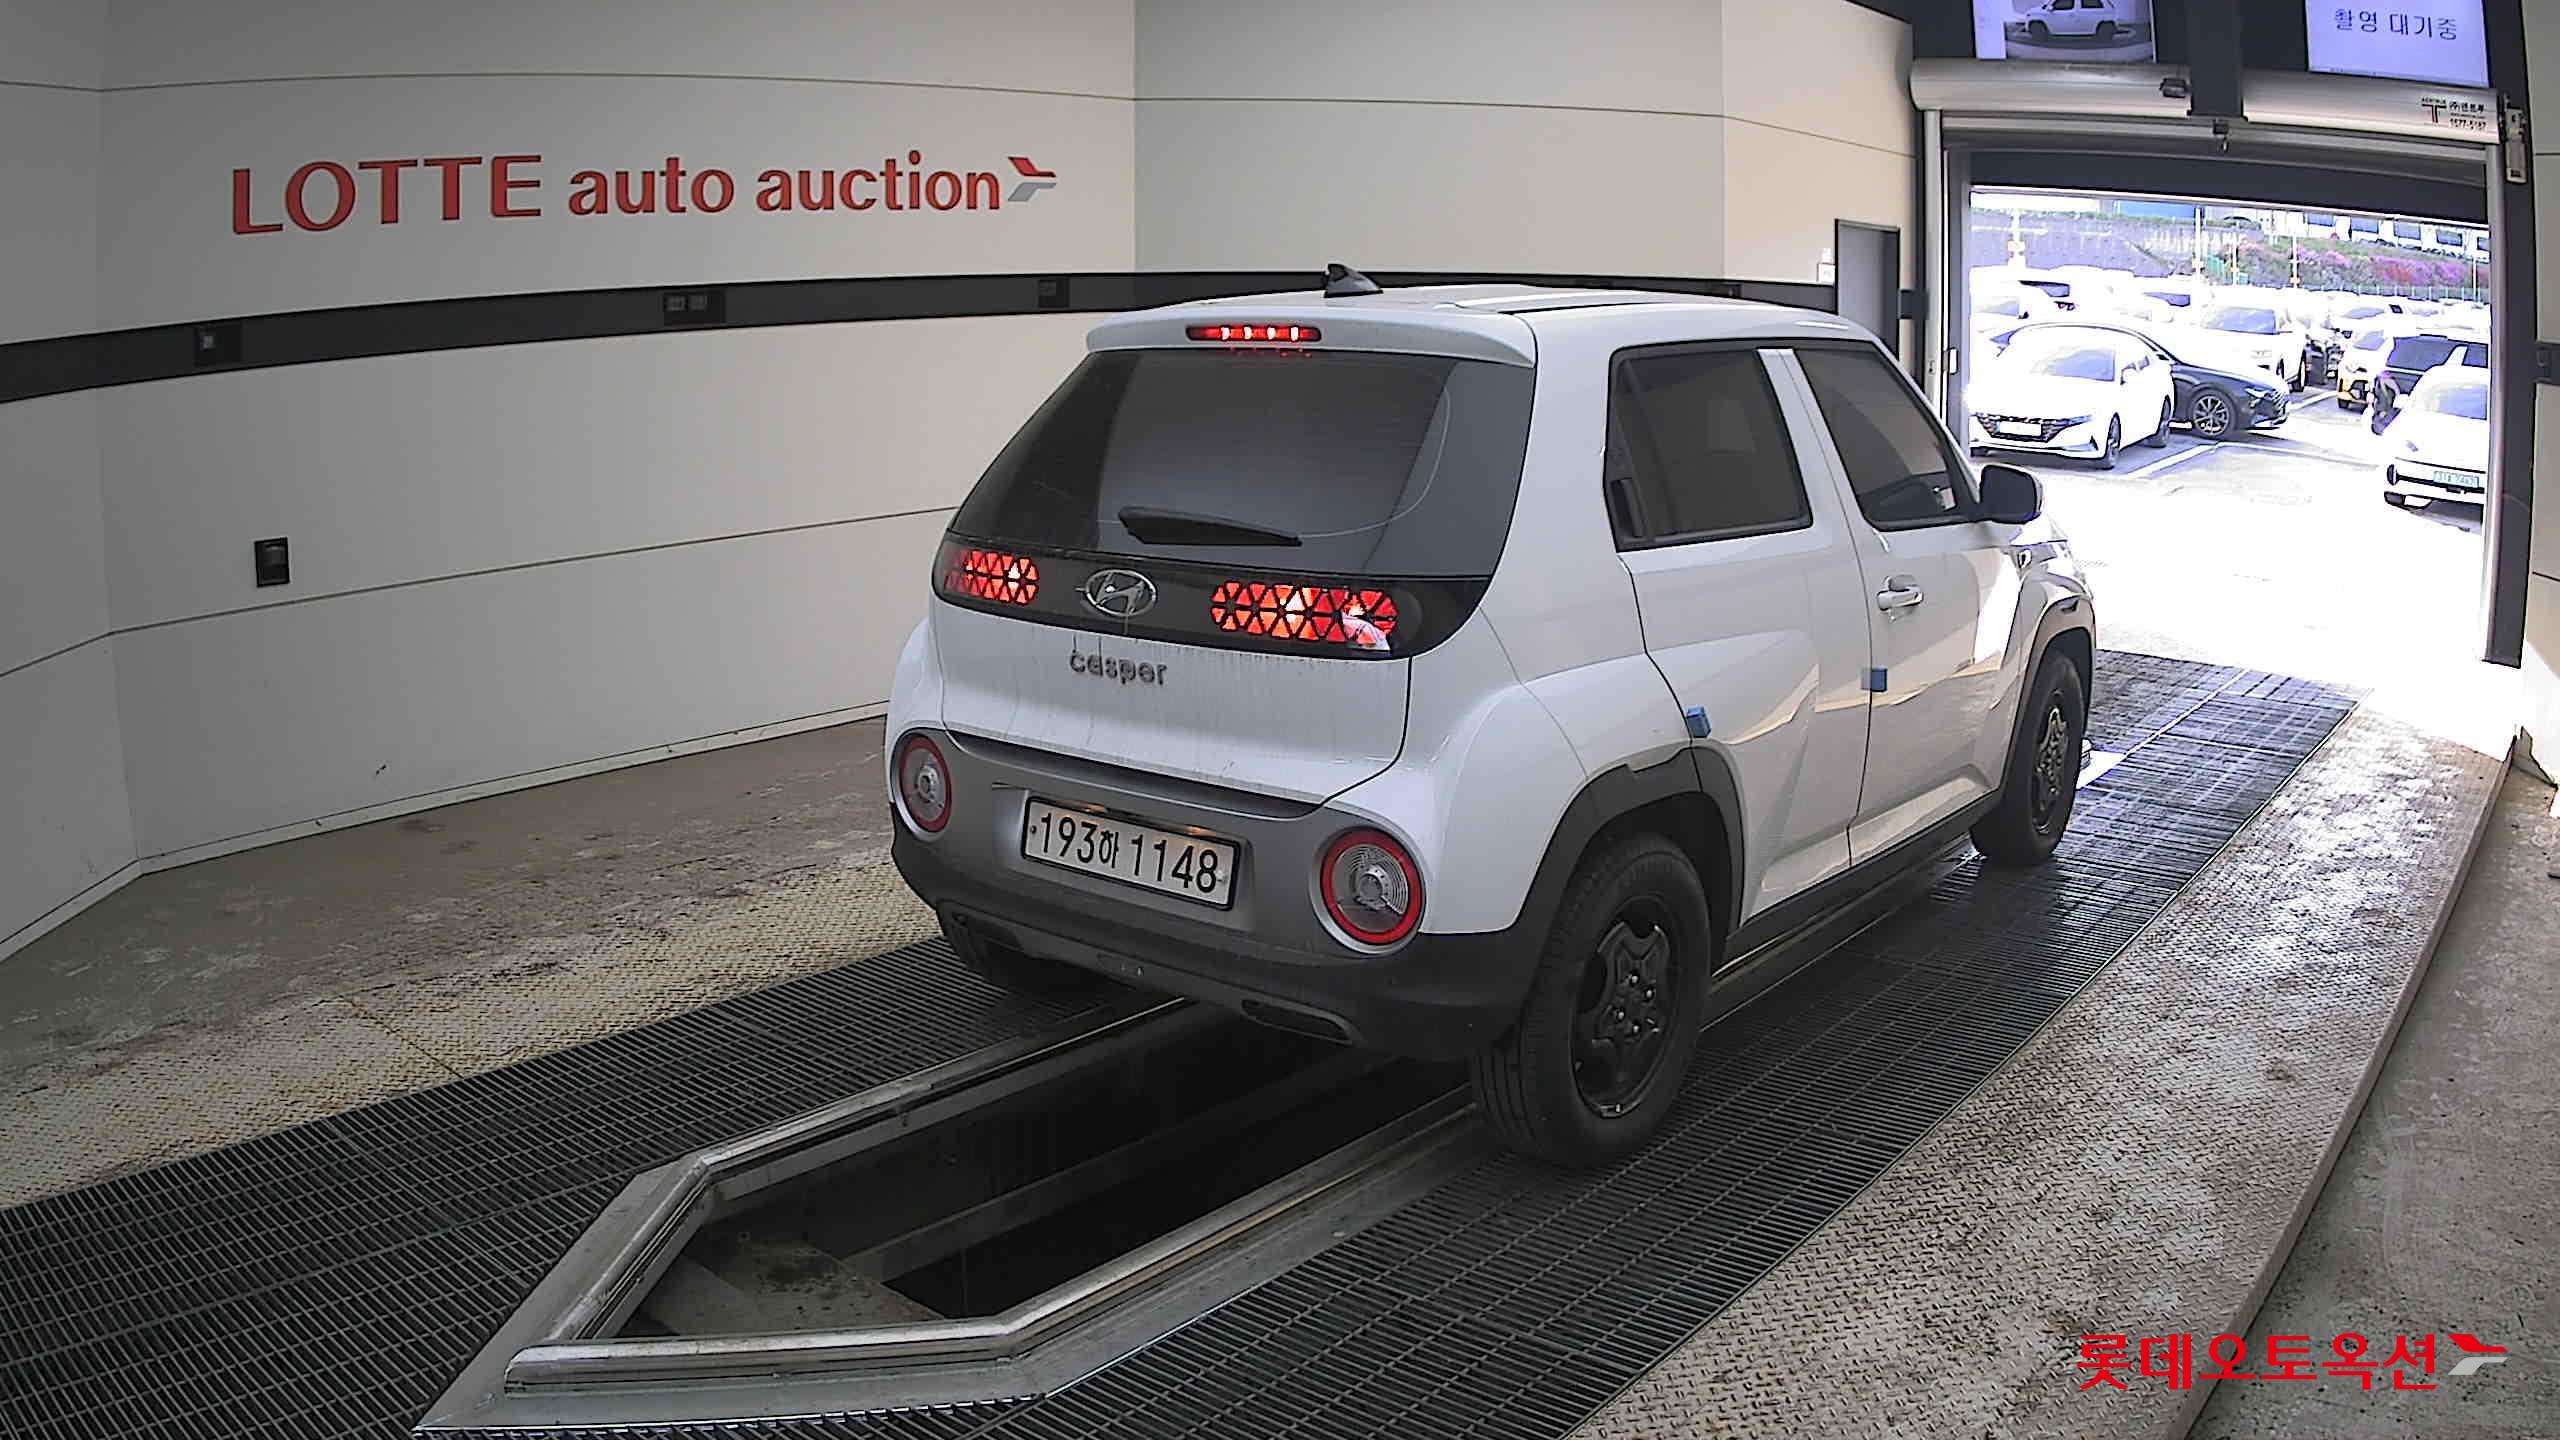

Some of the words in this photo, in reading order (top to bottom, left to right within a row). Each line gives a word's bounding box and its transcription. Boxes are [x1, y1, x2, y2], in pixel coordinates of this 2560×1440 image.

[2334, 8, 2378, 33] 촬영
[2389, 13, 2457, 41] 대기중
[233, 155, 540, 235] LOTTE
[568, 156, 736, 217] auto
[754, 150, 1005, 214] auction
[1069, 651, 1168, 686] casper
